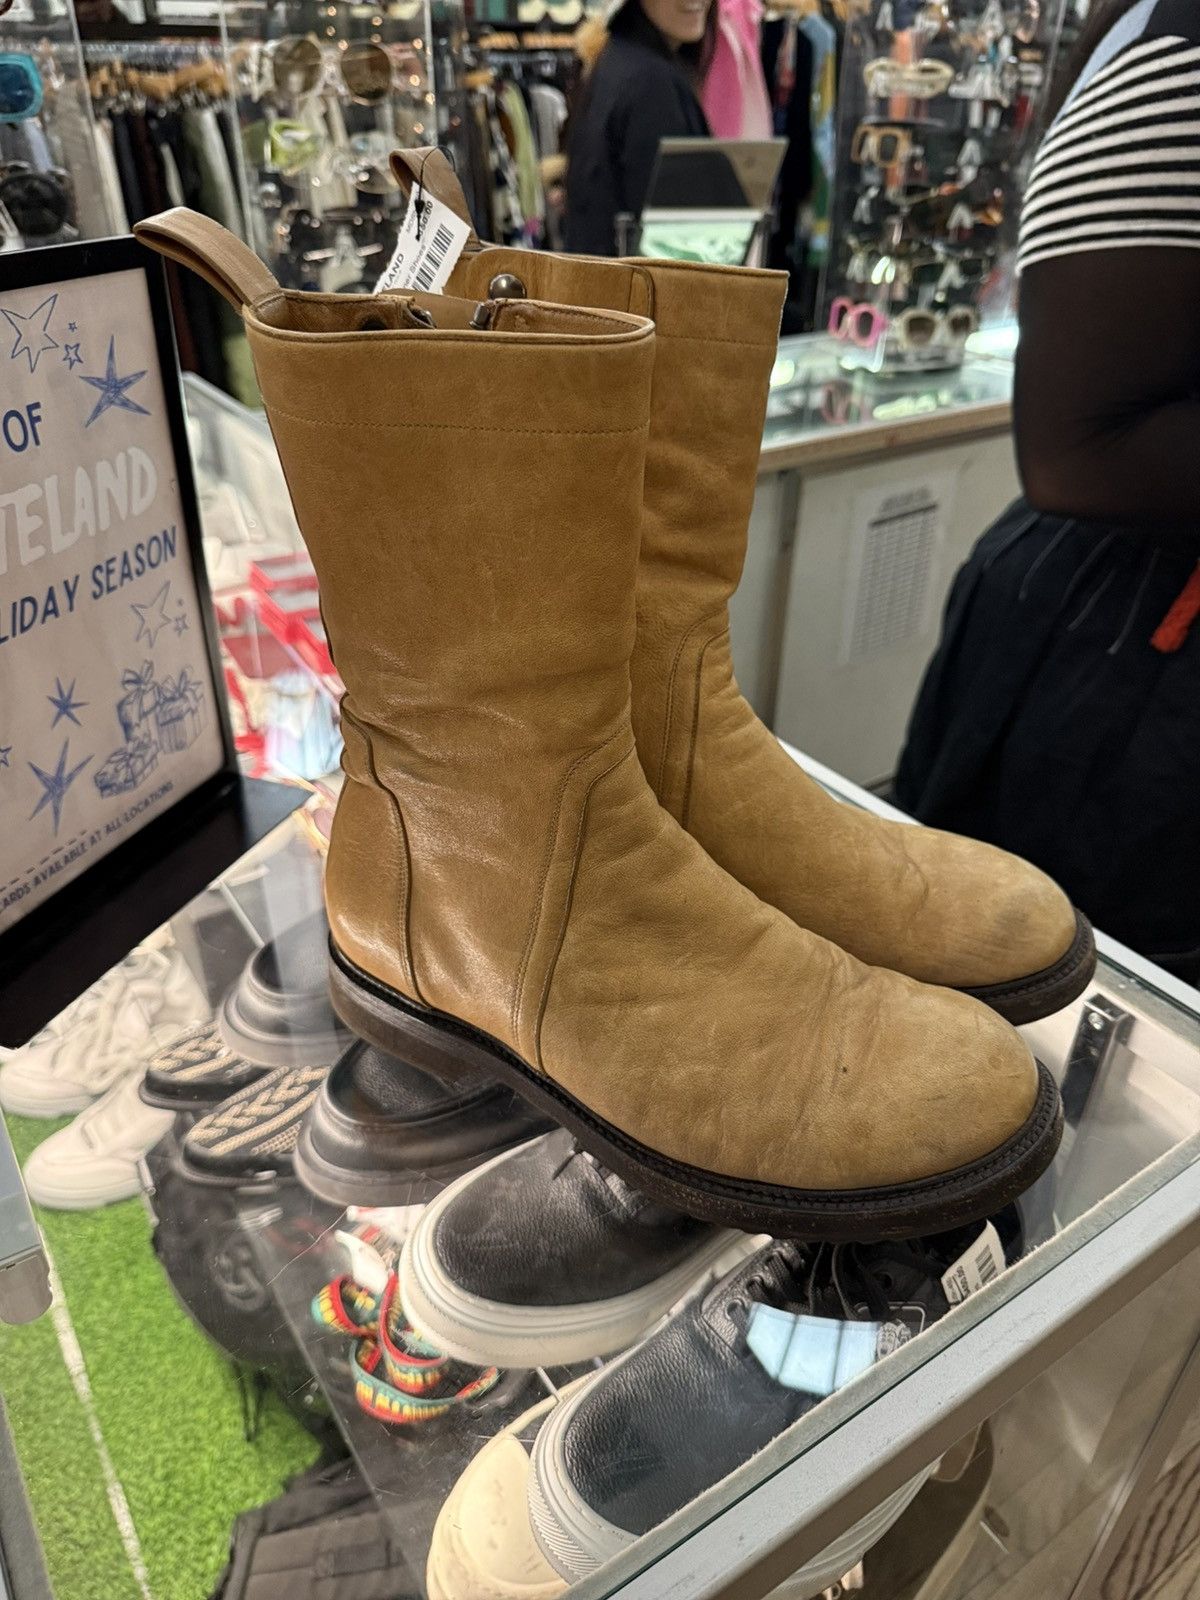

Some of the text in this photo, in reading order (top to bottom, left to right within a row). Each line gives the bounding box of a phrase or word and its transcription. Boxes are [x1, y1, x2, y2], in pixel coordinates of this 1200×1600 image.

[3, 401, 42, 452] OF
[91, 526, 176, 600] SEASON
[0, 780, 174, 914] ARDS AVAILABLE AT ALL LOCATIONS
